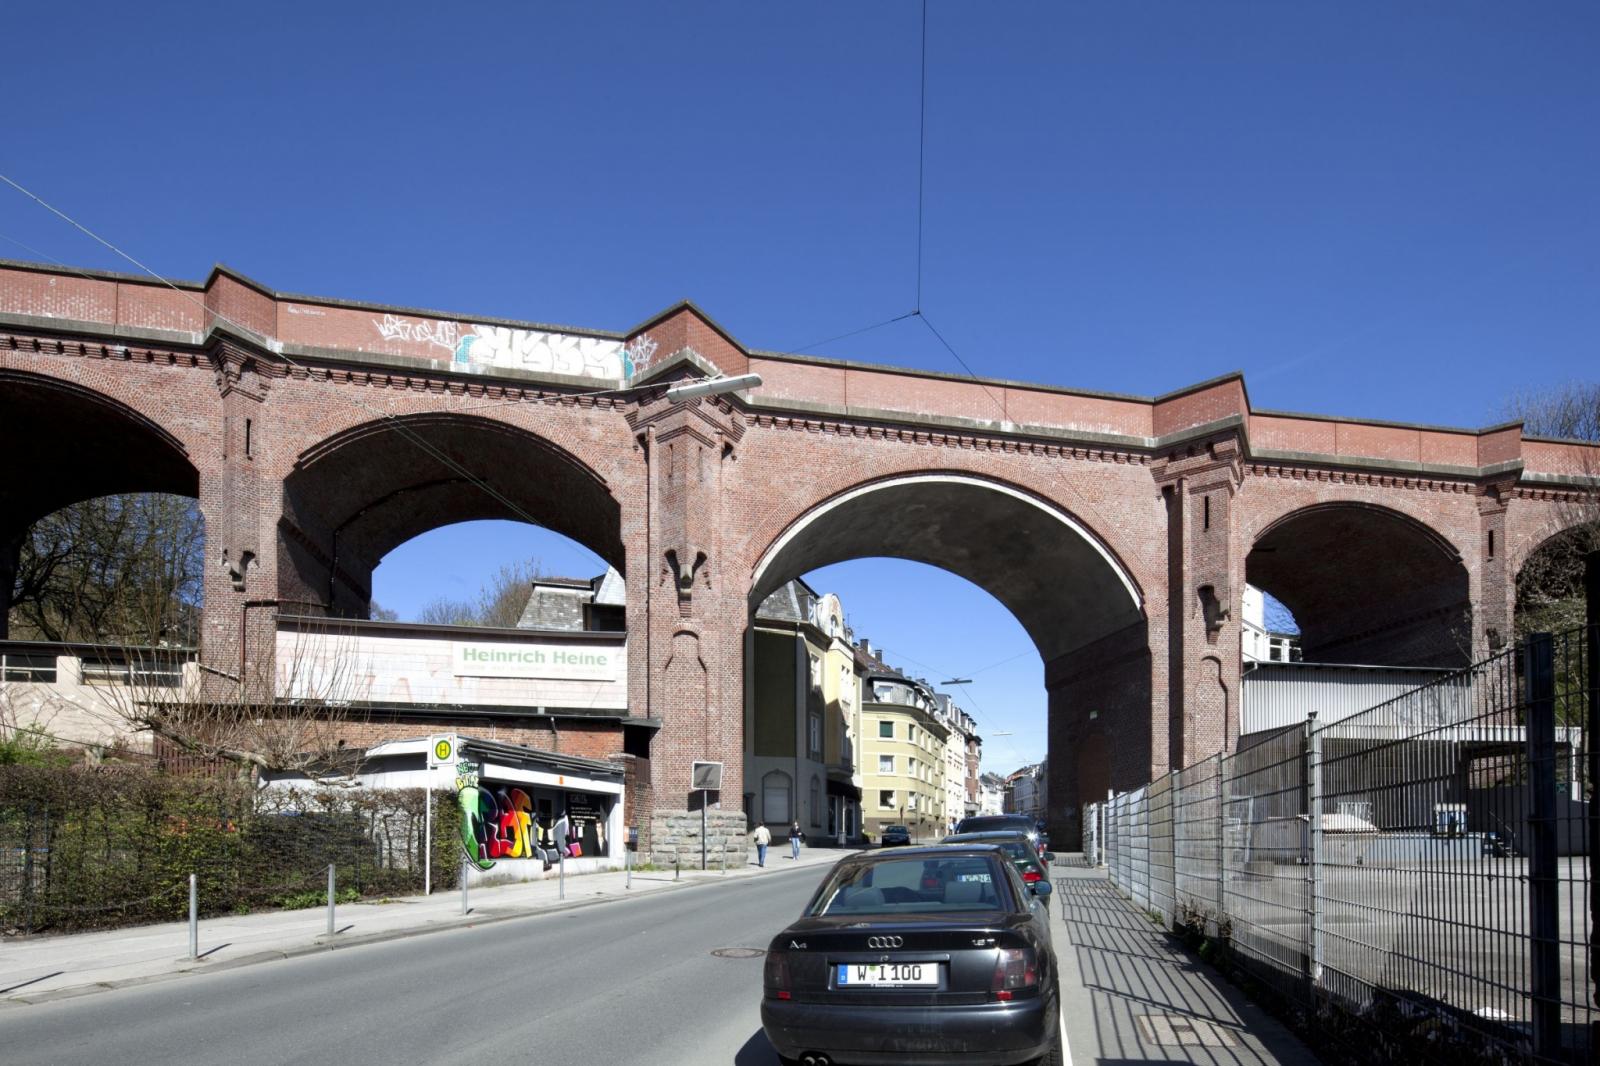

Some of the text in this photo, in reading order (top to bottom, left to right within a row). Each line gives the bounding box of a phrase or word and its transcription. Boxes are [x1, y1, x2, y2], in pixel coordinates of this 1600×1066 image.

[463, 648, 607, 666] Heinrich Heine
[440, 744, 447, 756] H
